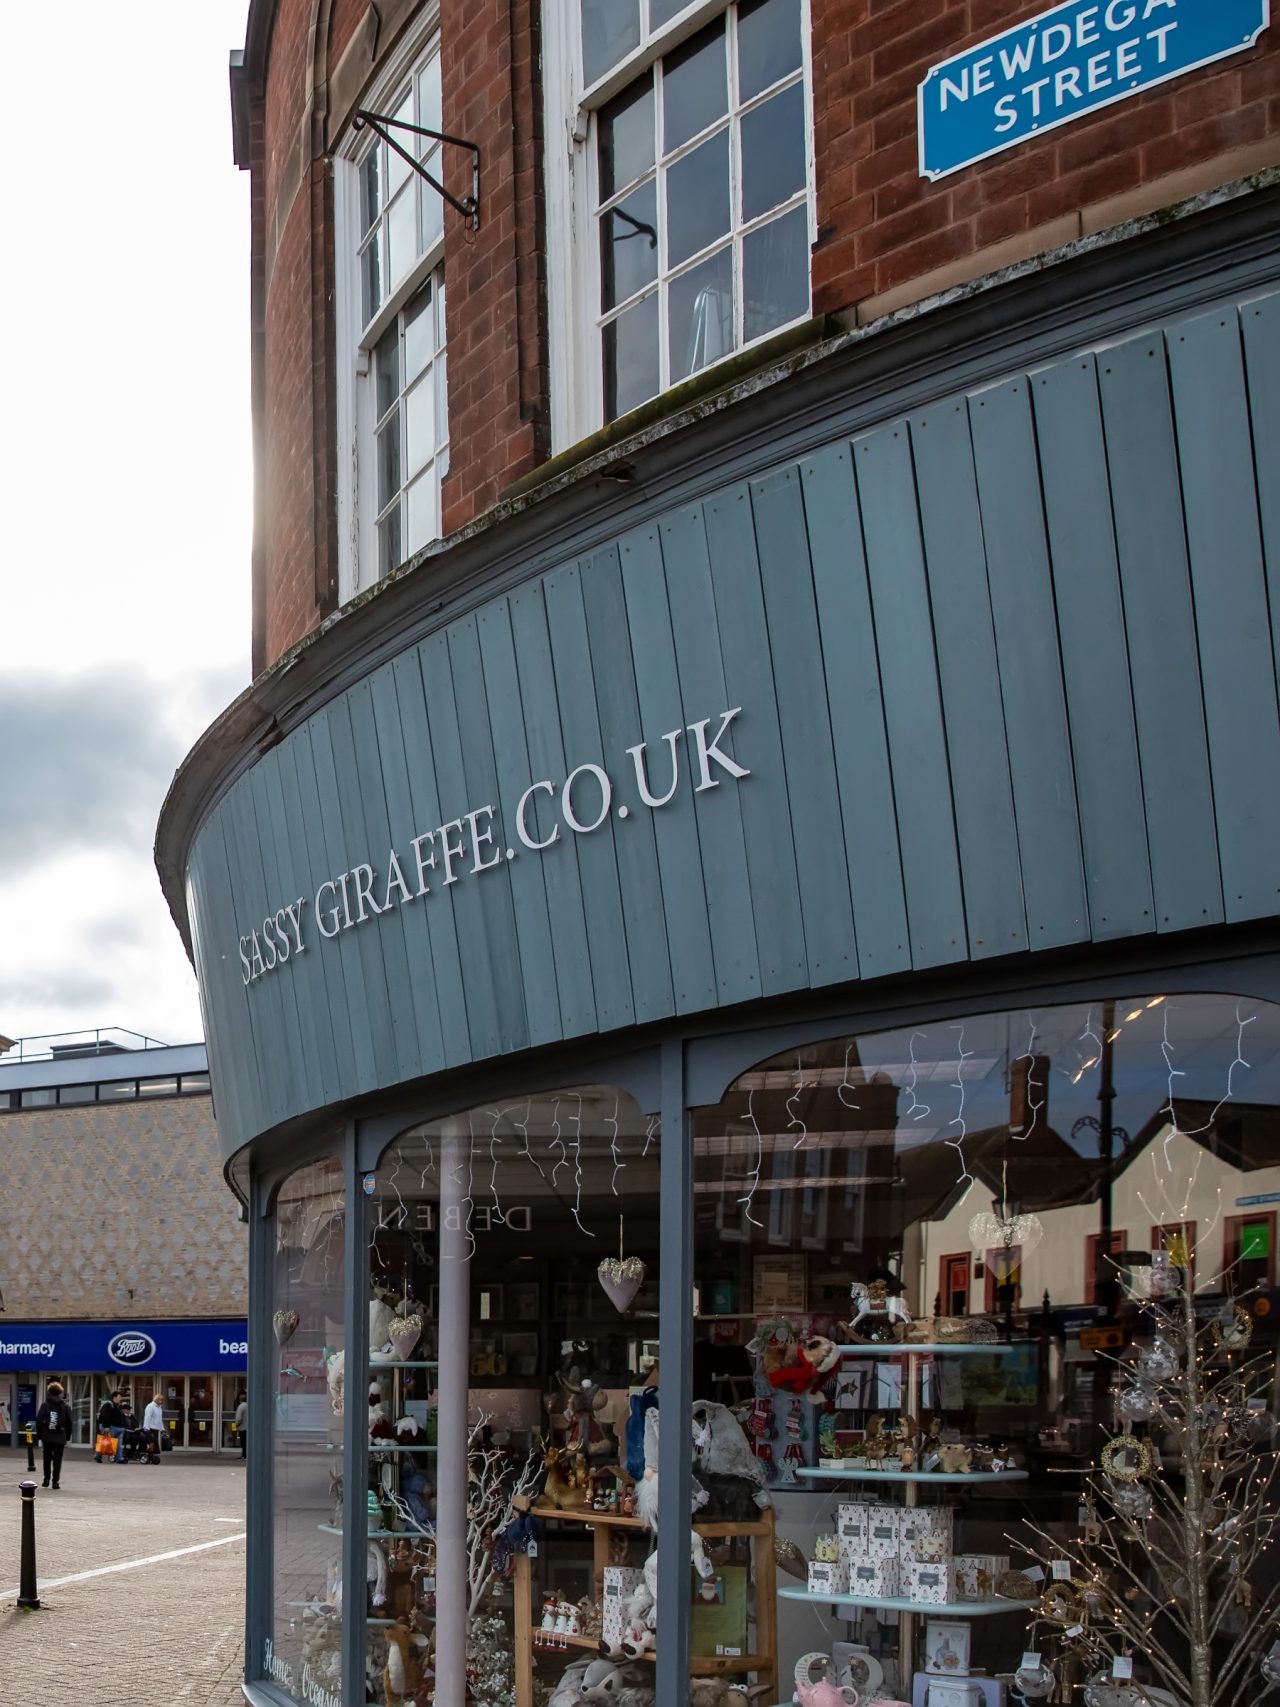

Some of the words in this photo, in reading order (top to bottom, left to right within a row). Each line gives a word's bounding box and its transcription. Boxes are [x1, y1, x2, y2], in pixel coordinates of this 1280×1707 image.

[993, 22, 1178, 133] STREET
[237, 896, 306, 986] SASSY
[314, 706, 751, 940] GIRAFFE.CO.UK
[115, 1339, 146, 1358] Boots
[219, 1338, 248, 1354] bea
[263, 1638, 290, 1686] Home
